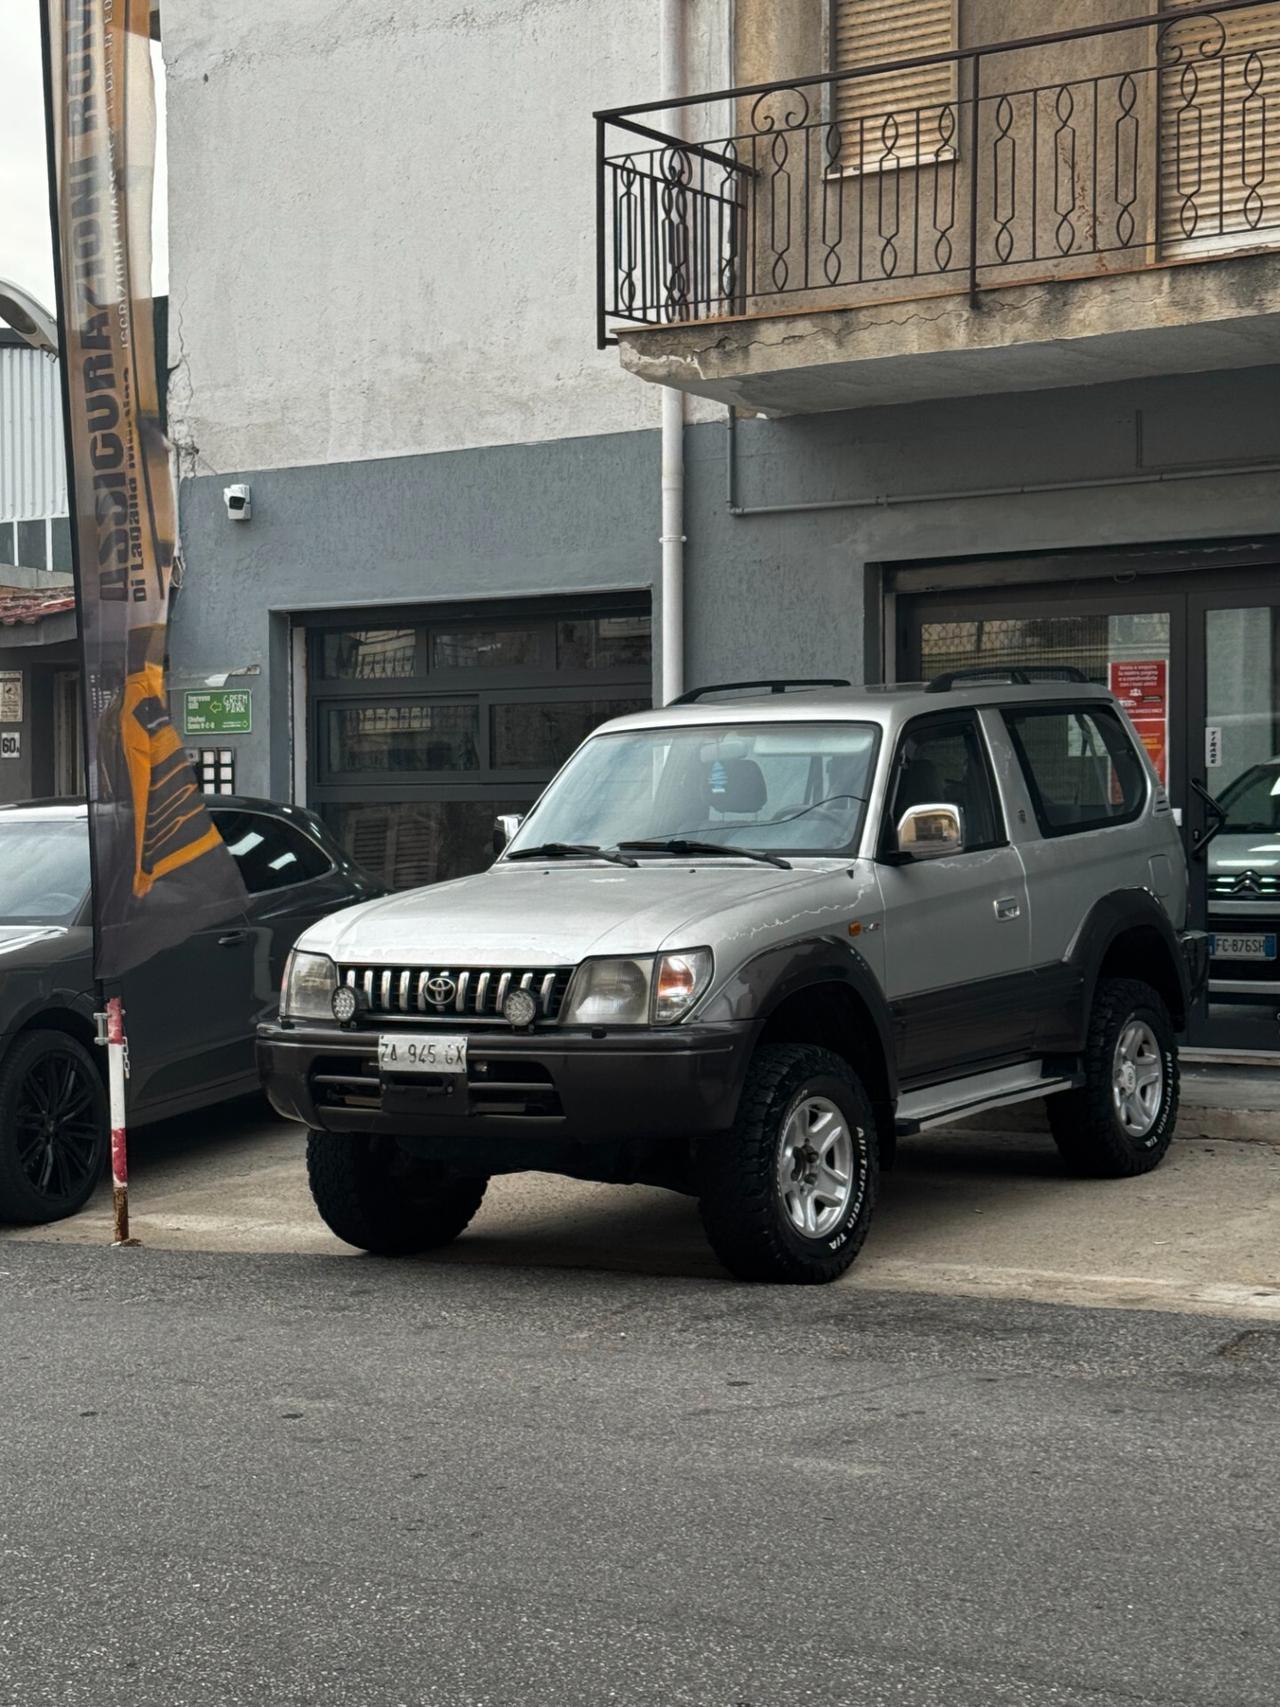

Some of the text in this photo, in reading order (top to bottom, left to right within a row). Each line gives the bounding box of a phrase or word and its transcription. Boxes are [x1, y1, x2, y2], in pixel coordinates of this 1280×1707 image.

[223, 694, 248, 705] GREEN
[225, 703, 246, 713] PARK
[408, 1044, 436, 1064] 945
[829, 1126, 868, 1250] All-Terrain T/A
